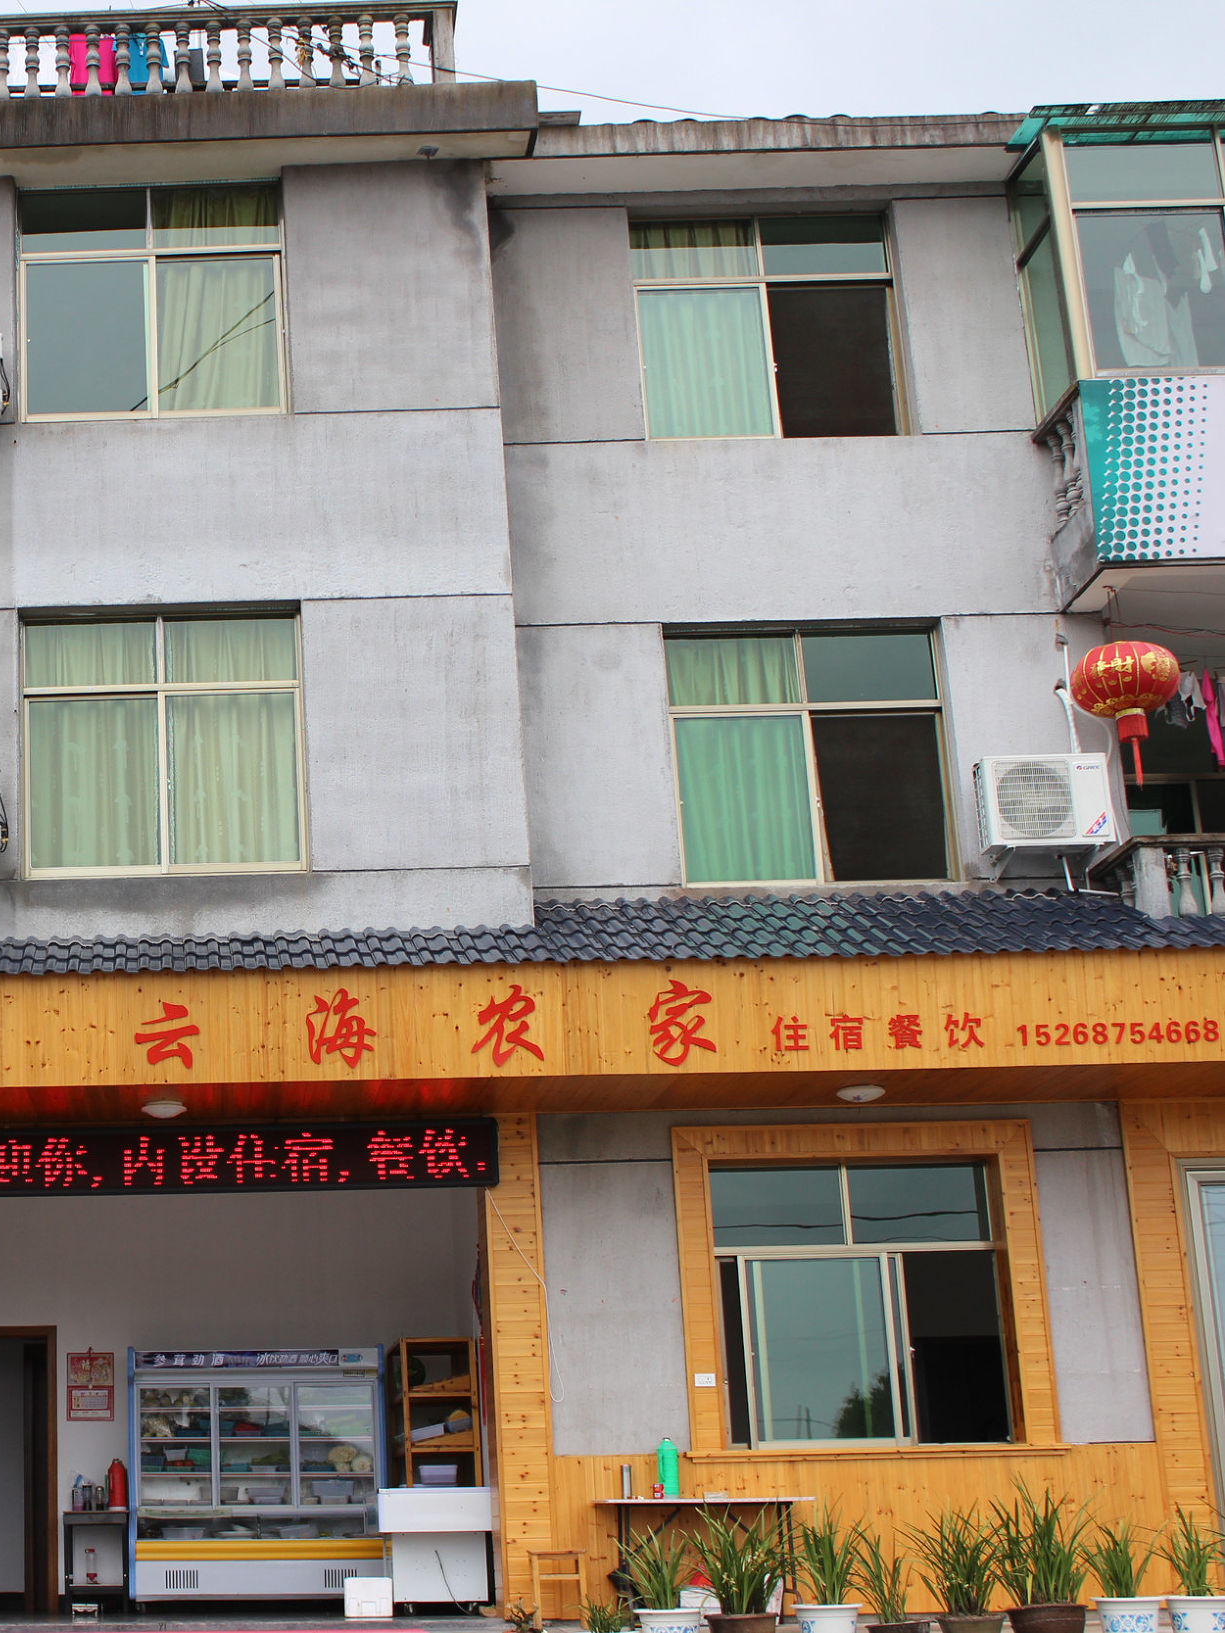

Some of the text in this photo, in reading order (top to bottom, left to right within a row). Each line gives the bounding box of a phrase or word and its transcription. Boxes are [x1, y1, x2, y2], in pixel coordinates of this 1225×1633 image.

[134, 979, 1220, 1070] 云海农家 住宿餐饮 15268754668
